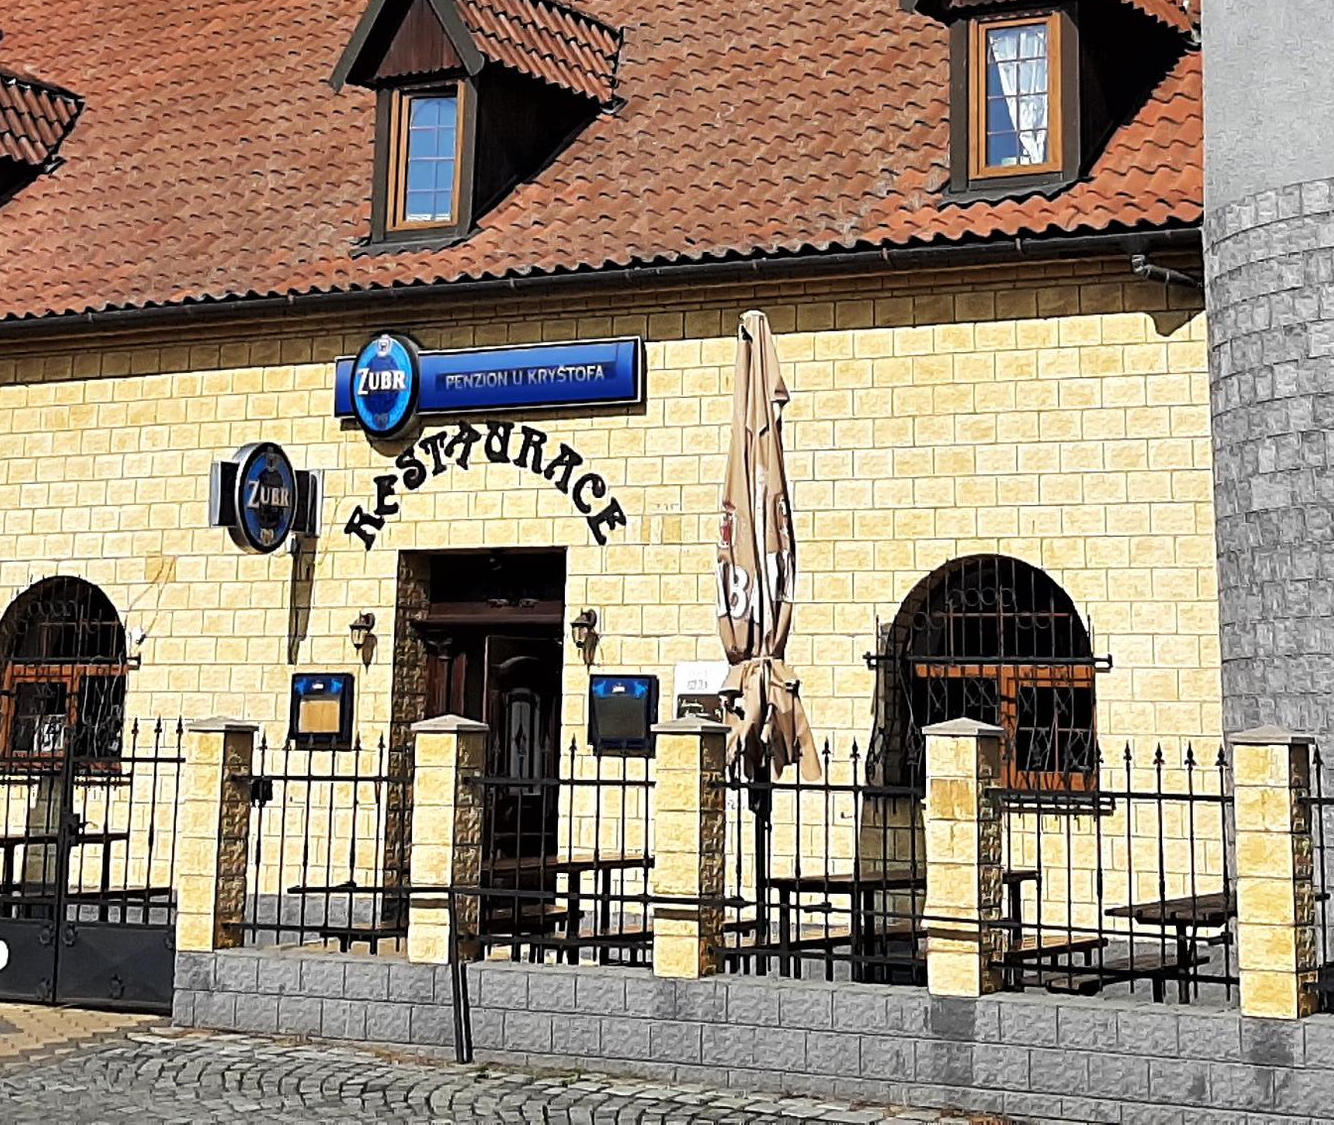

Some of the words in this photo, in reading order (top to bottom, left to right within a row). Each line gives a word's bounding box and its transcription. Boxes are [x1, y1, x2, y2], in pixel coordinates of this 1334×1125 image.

[356, 368, 407, 396] ZUBR
[445, 372, 508, 390] PENZION
[513, 371, 523, 385] U
[528, 364, 605, 385] KRYŠTOFA
[247, 479, 289, 508] ZUBR
[343, 420, 627, 552] RESTAURACE
